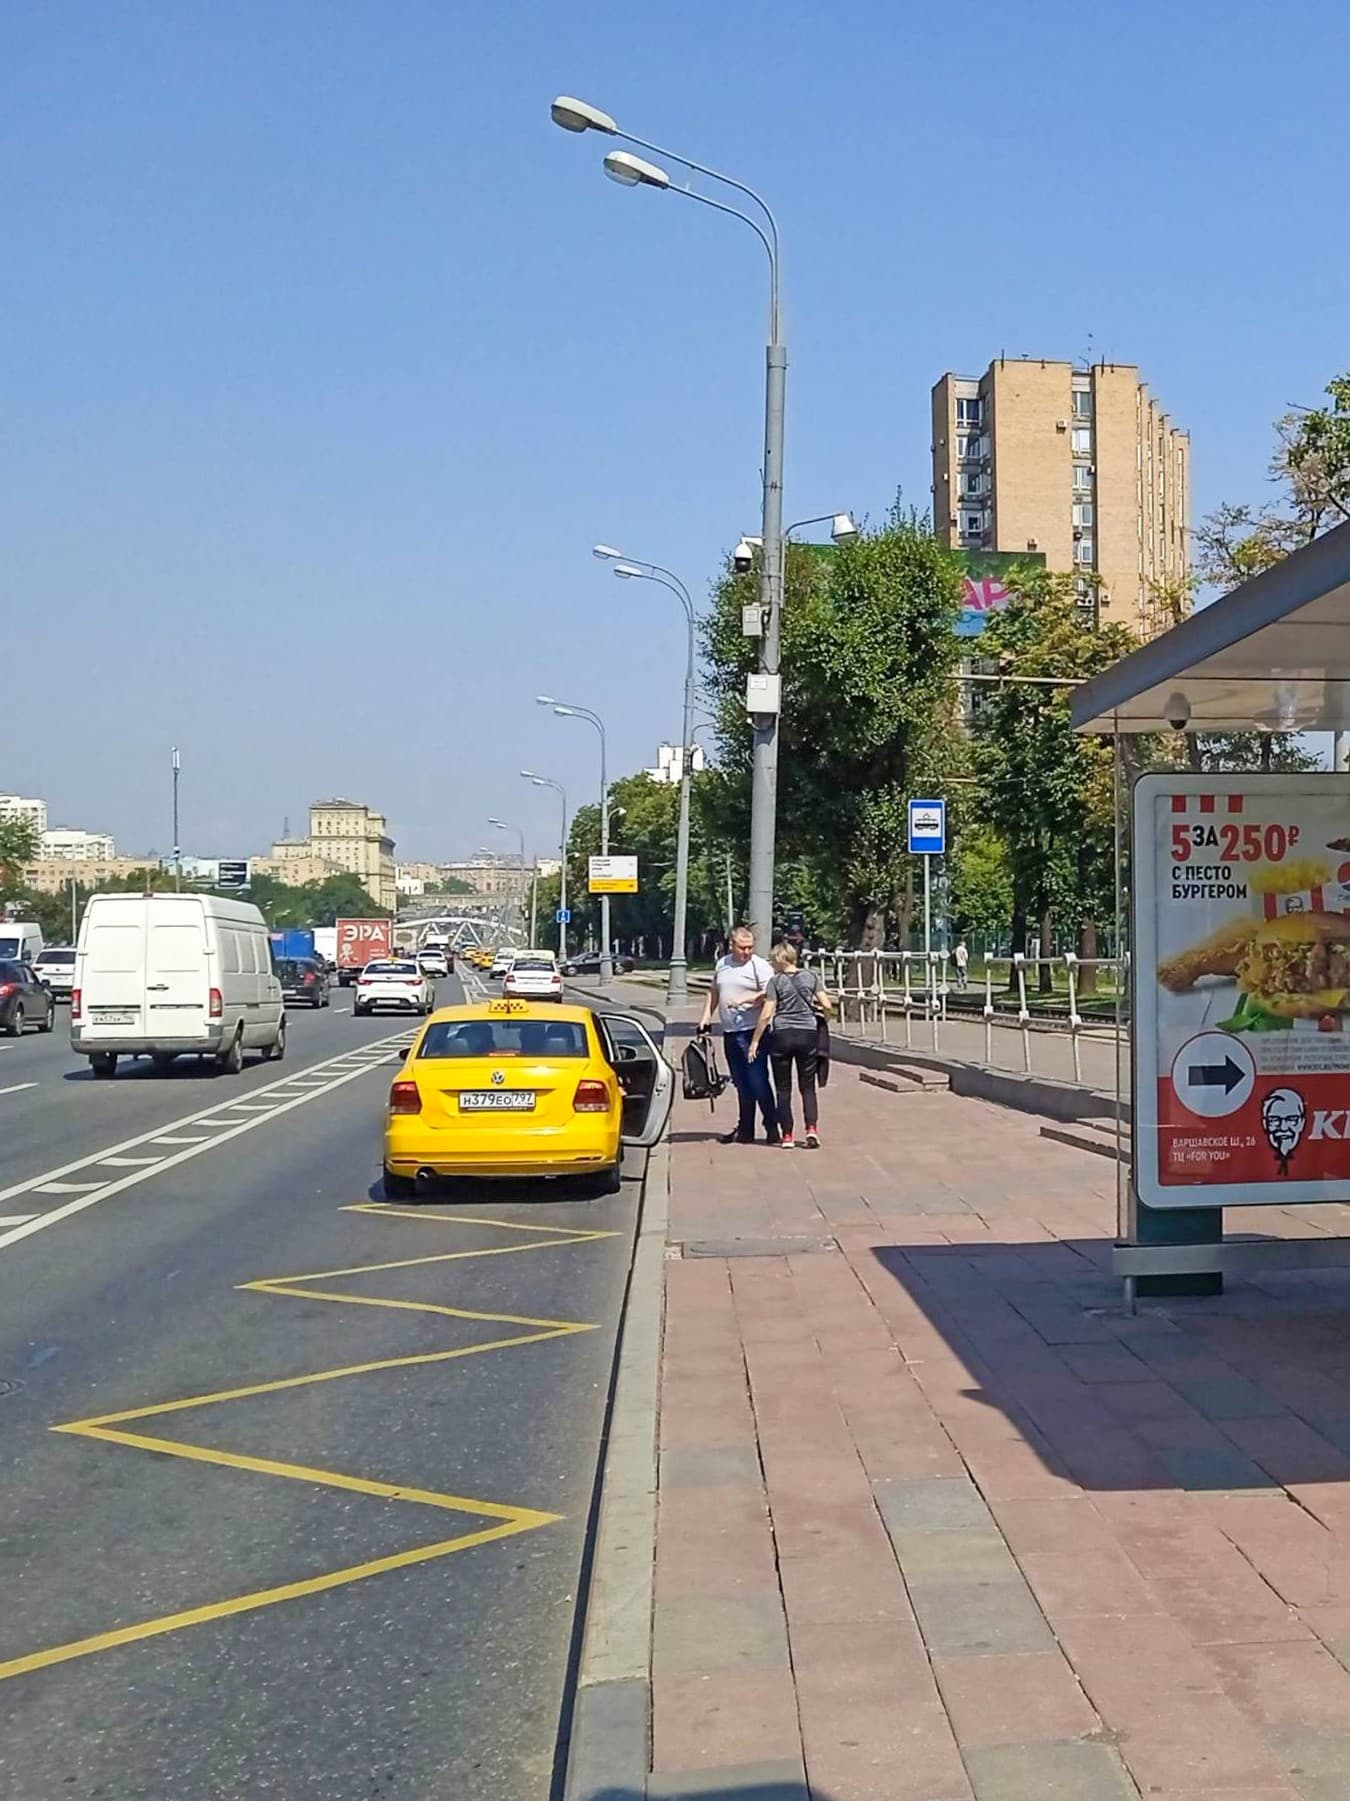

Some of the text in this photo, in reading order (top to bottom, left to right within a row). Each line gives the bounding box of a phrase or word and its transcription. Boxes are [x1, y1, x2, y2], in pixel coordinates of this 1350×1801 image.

[1171, 866, 1231, 881] С ПЕСТО
[1171, 884, 1248, 899] БУРГЕРОМ
[343, 924, 385, 941] ЭРА
[1172, 1137, 1228, 1149] ВАРШАВСКОЕ
[1173, 1151, 1185, 1162] ТЦ
